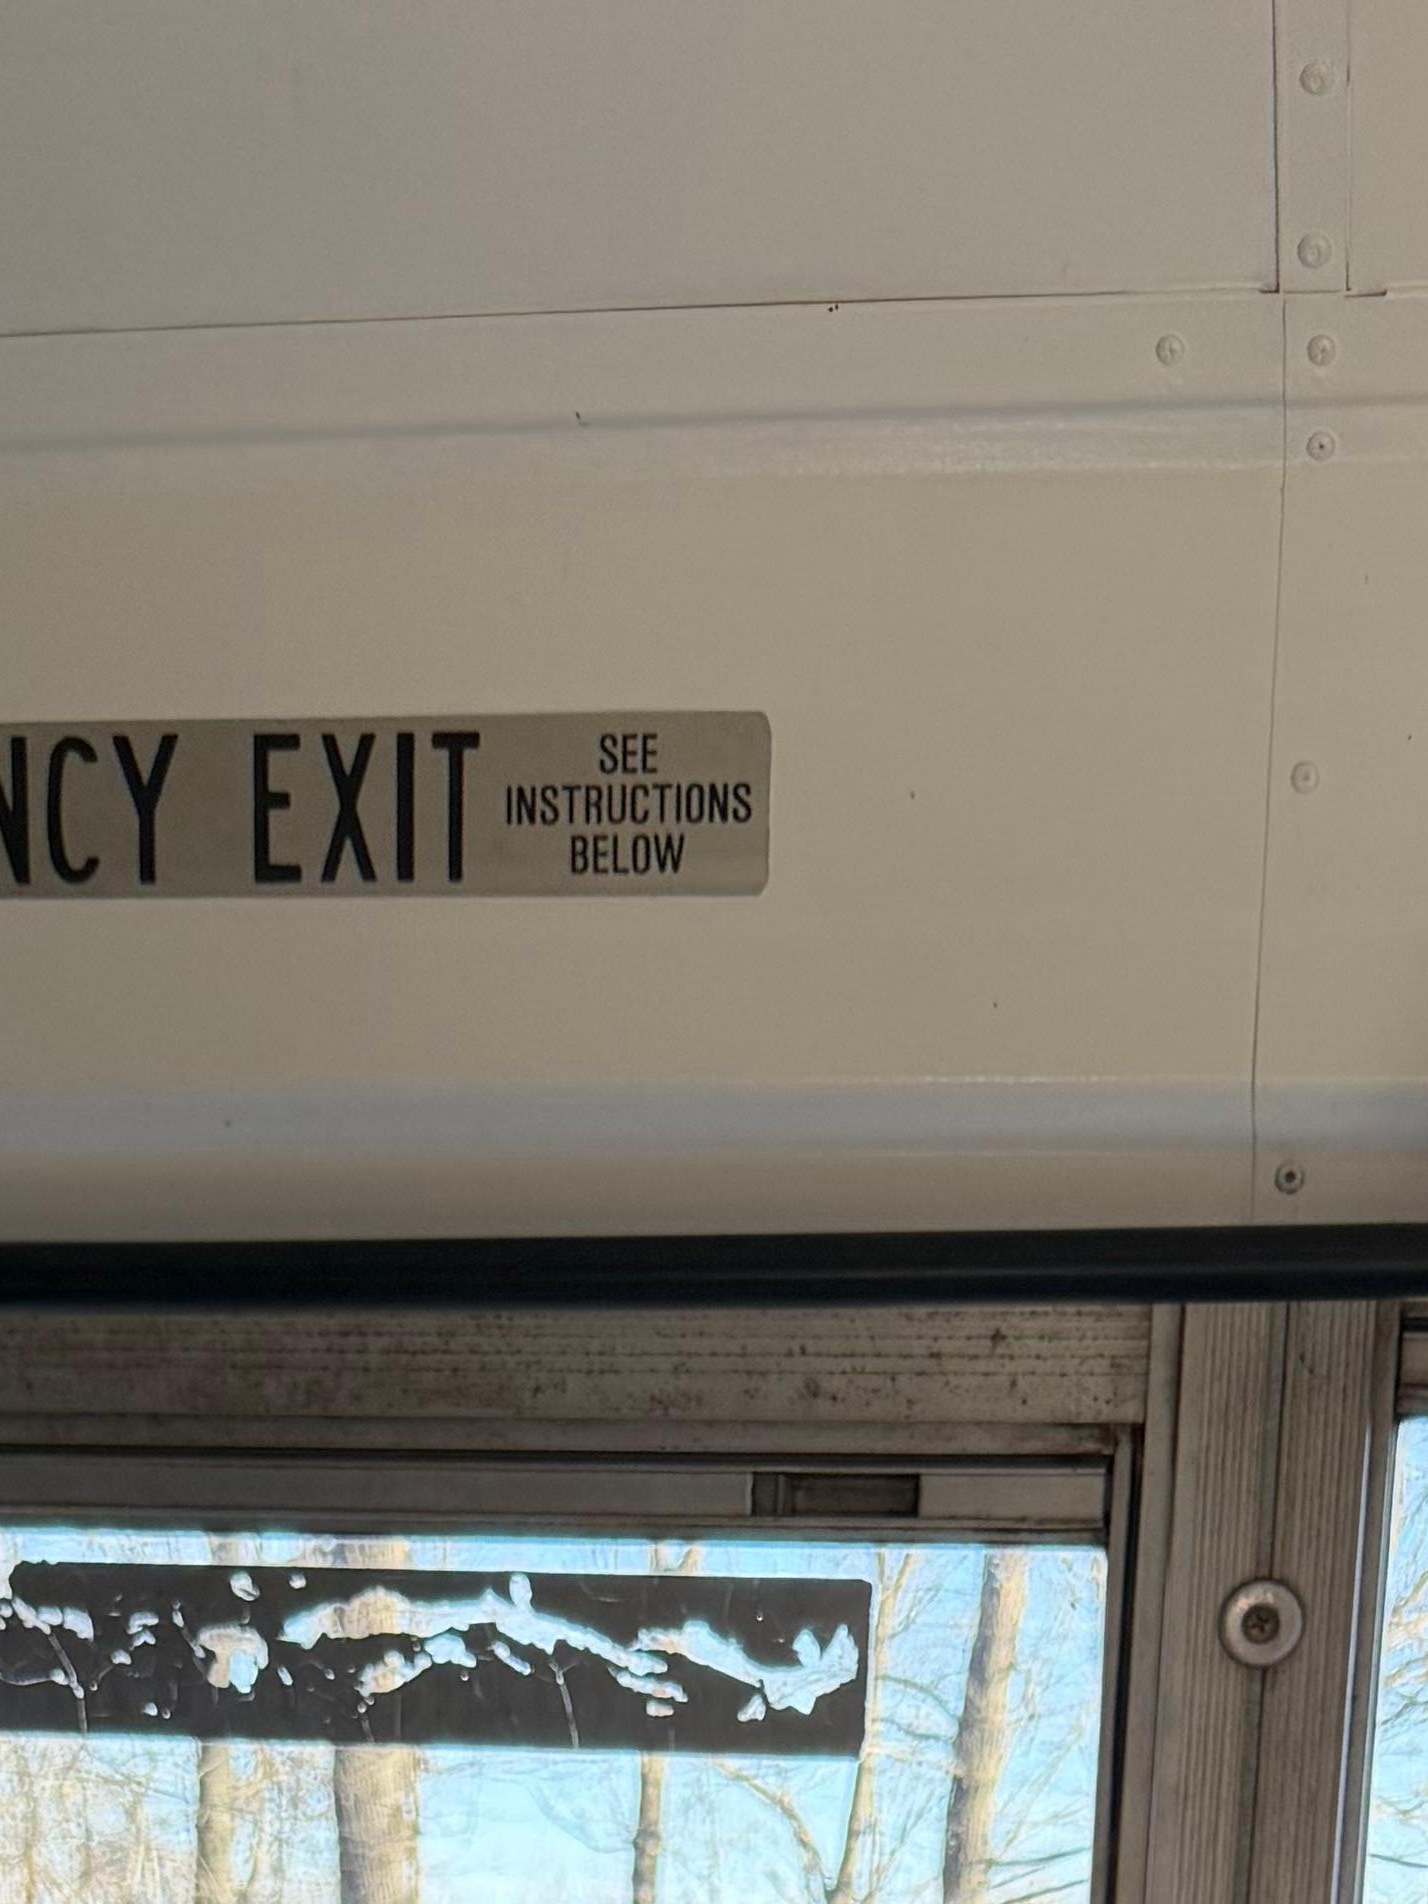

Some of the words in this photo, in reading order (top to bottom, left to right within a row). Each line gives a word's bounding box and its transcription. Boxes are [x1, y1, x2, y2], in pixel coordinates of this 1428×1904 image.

[598, 734, 658, 775] SEE
[253, 732, 480, 884] EXIT
[505, 783, 752, 826] INSTRUCTIONS
[570, 833, 684, 874] BELOW
